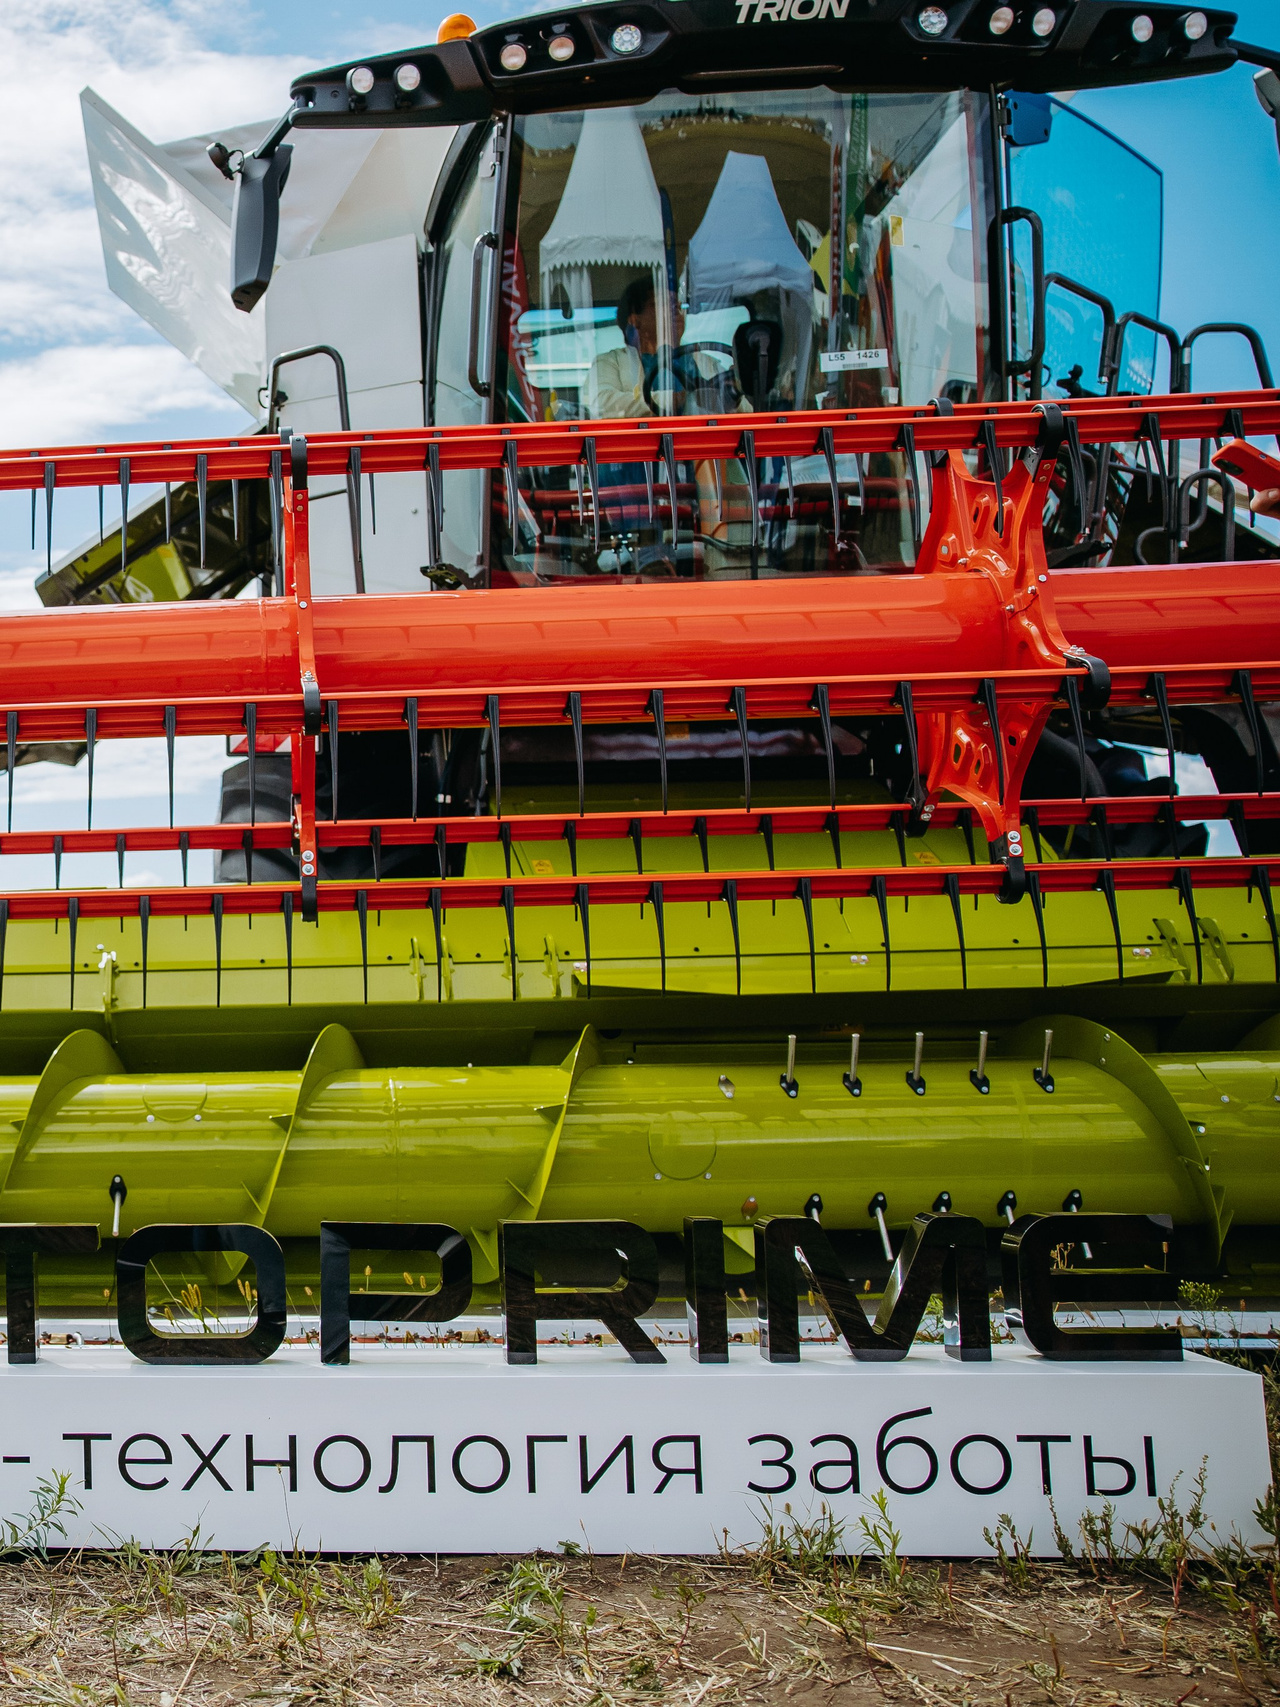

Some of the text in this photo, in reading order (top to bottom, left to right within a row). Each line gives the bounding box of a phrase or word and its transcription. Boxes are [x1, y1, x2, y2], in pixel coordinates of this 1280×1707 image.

[735, 0, 850, 24] TRION
[62, 1432, 704, 1495] технология
[746, 1405, 1157, 1497] заботы
